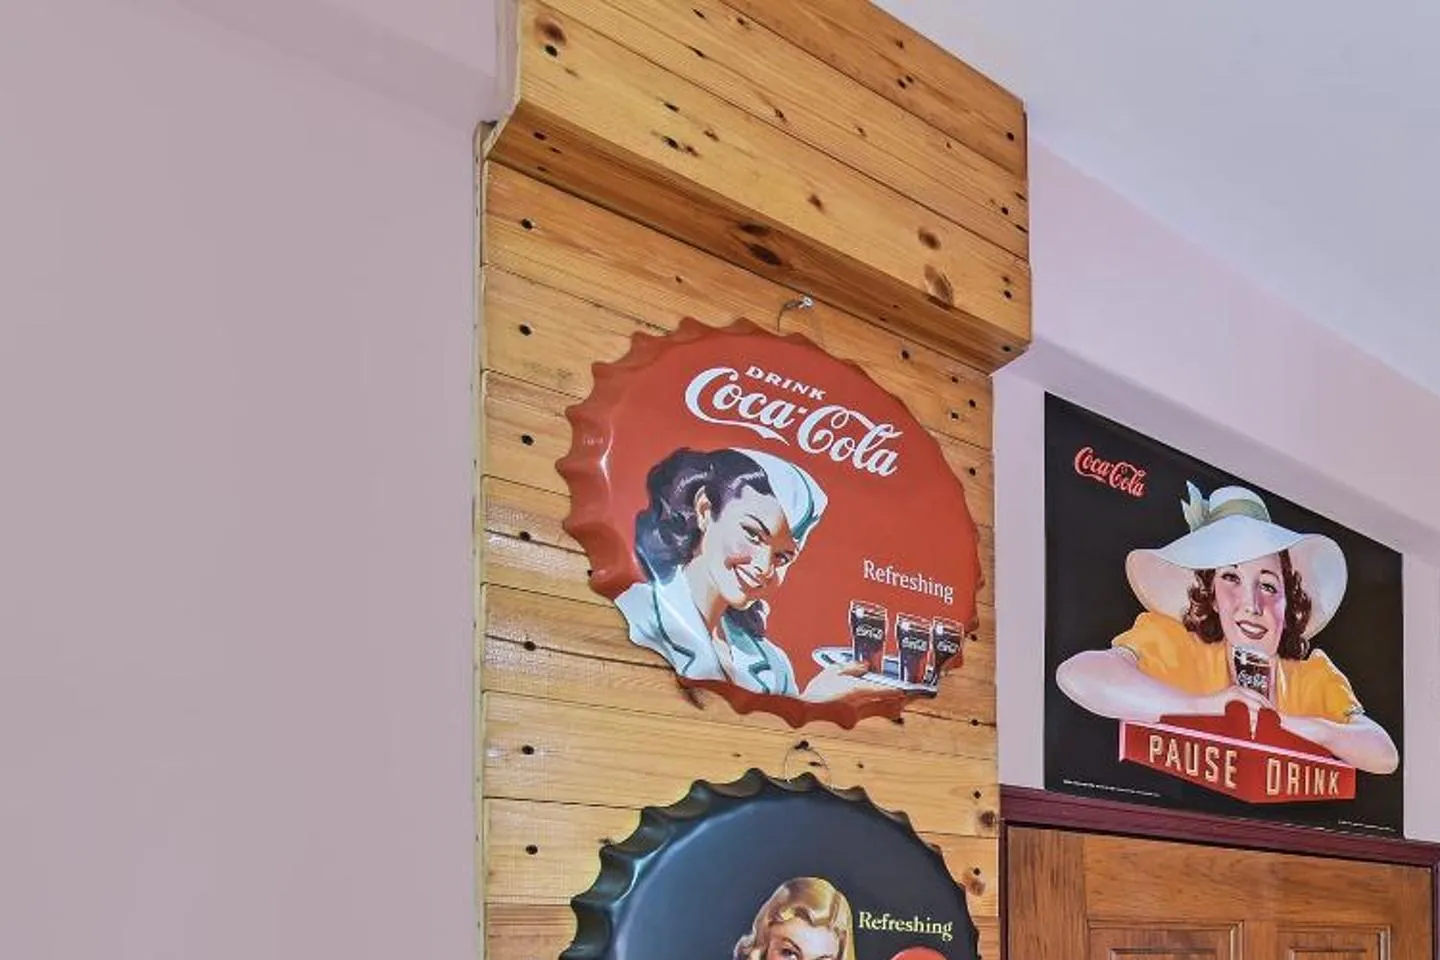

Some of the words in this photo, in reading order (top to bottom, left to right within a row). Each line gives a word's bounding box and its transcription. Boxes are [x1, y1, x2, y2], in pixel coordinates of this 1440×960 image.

[745, 366, 827, 401] DRINK
[685, 367, 902, 477] Coca-Cola
[1074, 447, 1146, 497] Coca-Cola
[863, 560, 954, 604] Refreshing
[1148, 735, 1238, 789] PAUSE
[1266, 758, 1340, 797] DRINK
[859, 911, 953, 941] Refreshing
